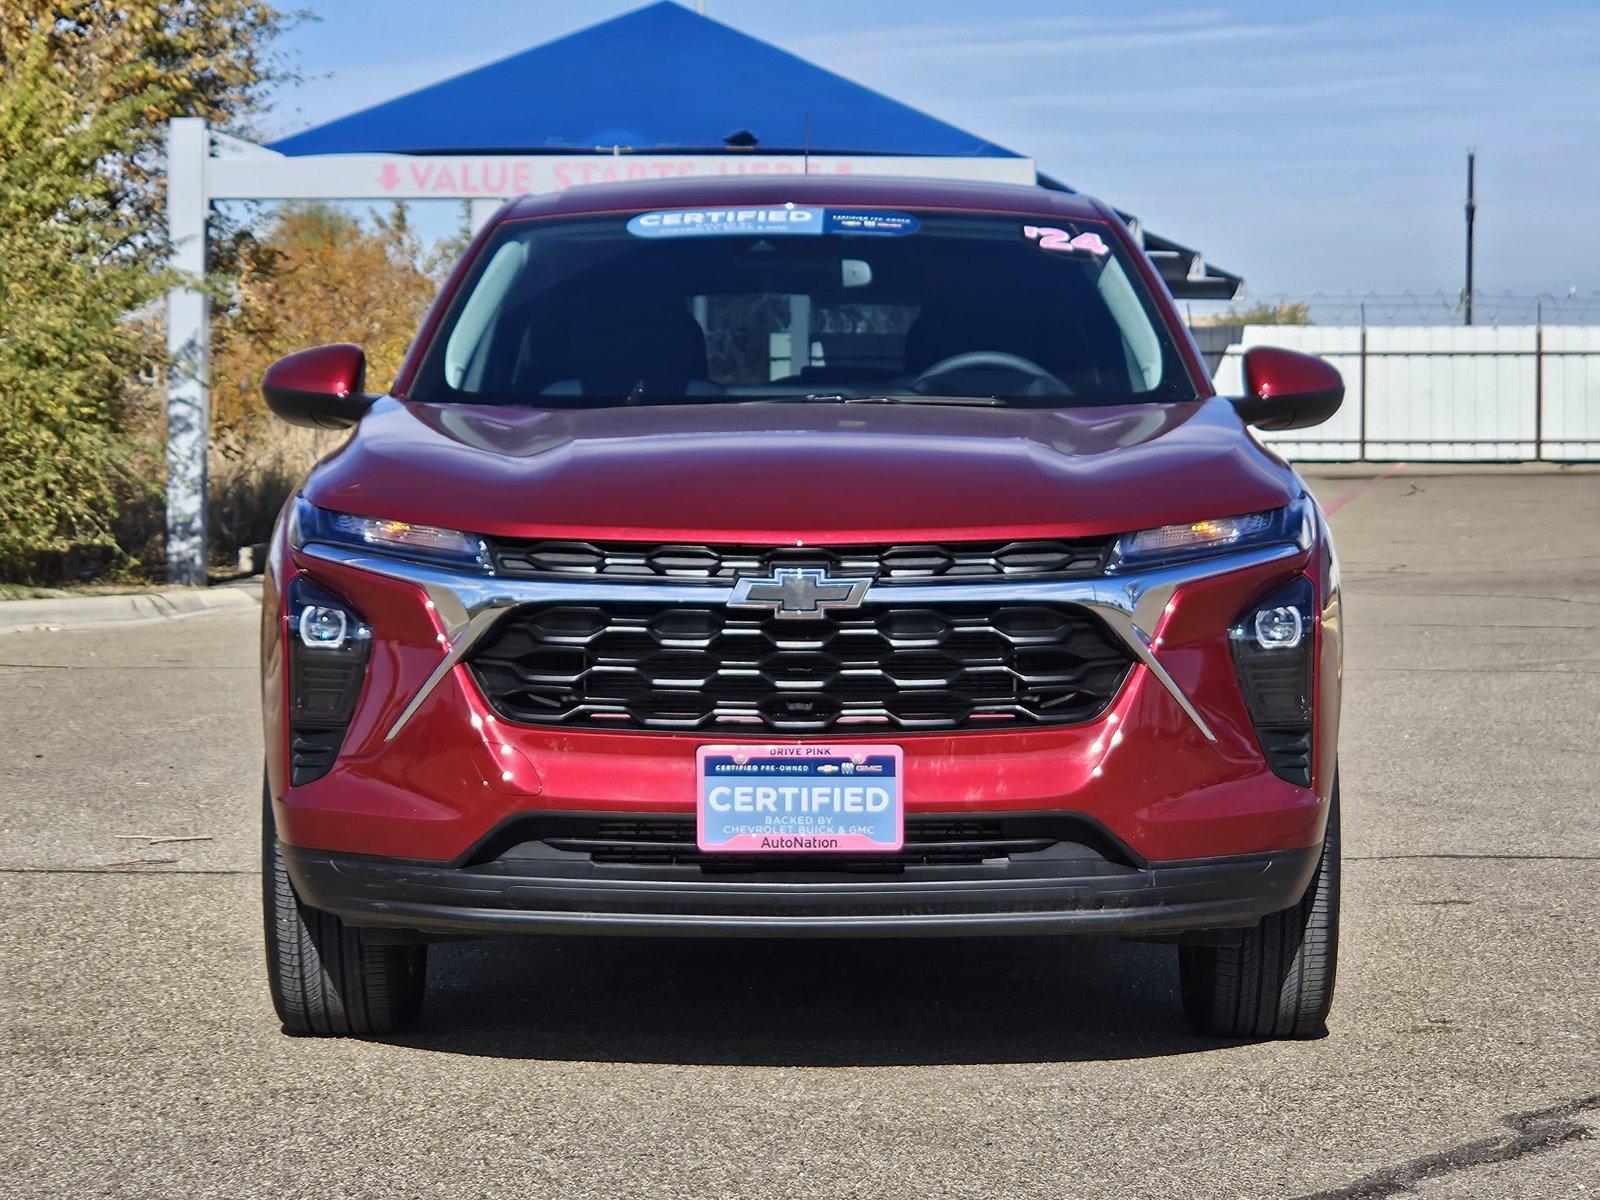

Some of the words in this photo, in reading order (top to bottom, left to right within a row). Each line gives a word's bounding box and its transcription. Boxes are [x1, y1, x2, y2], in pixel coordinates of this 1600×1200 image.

[408, 161, 533, 194] VALUE
[639, 210, 812, 226] CERTIFIED
[769, 748, 802, 756] DRIVE
[806, 748, 832, 756] PINK
[715, 764, 758, 772] CERTIFIED
[709, 786, 889, 812] CERTIFIED
[765, 816, 813, 825] BACKED
[818, 816, 833, 825] BY
[723, 826, 793, 835] CHEVROLET
[799, 826, 834, 835] BUICK
[838, 826, 846, 835] &
[849, 826, 875, 835] GMC
[761, 837, 838, 849] AutoNation
